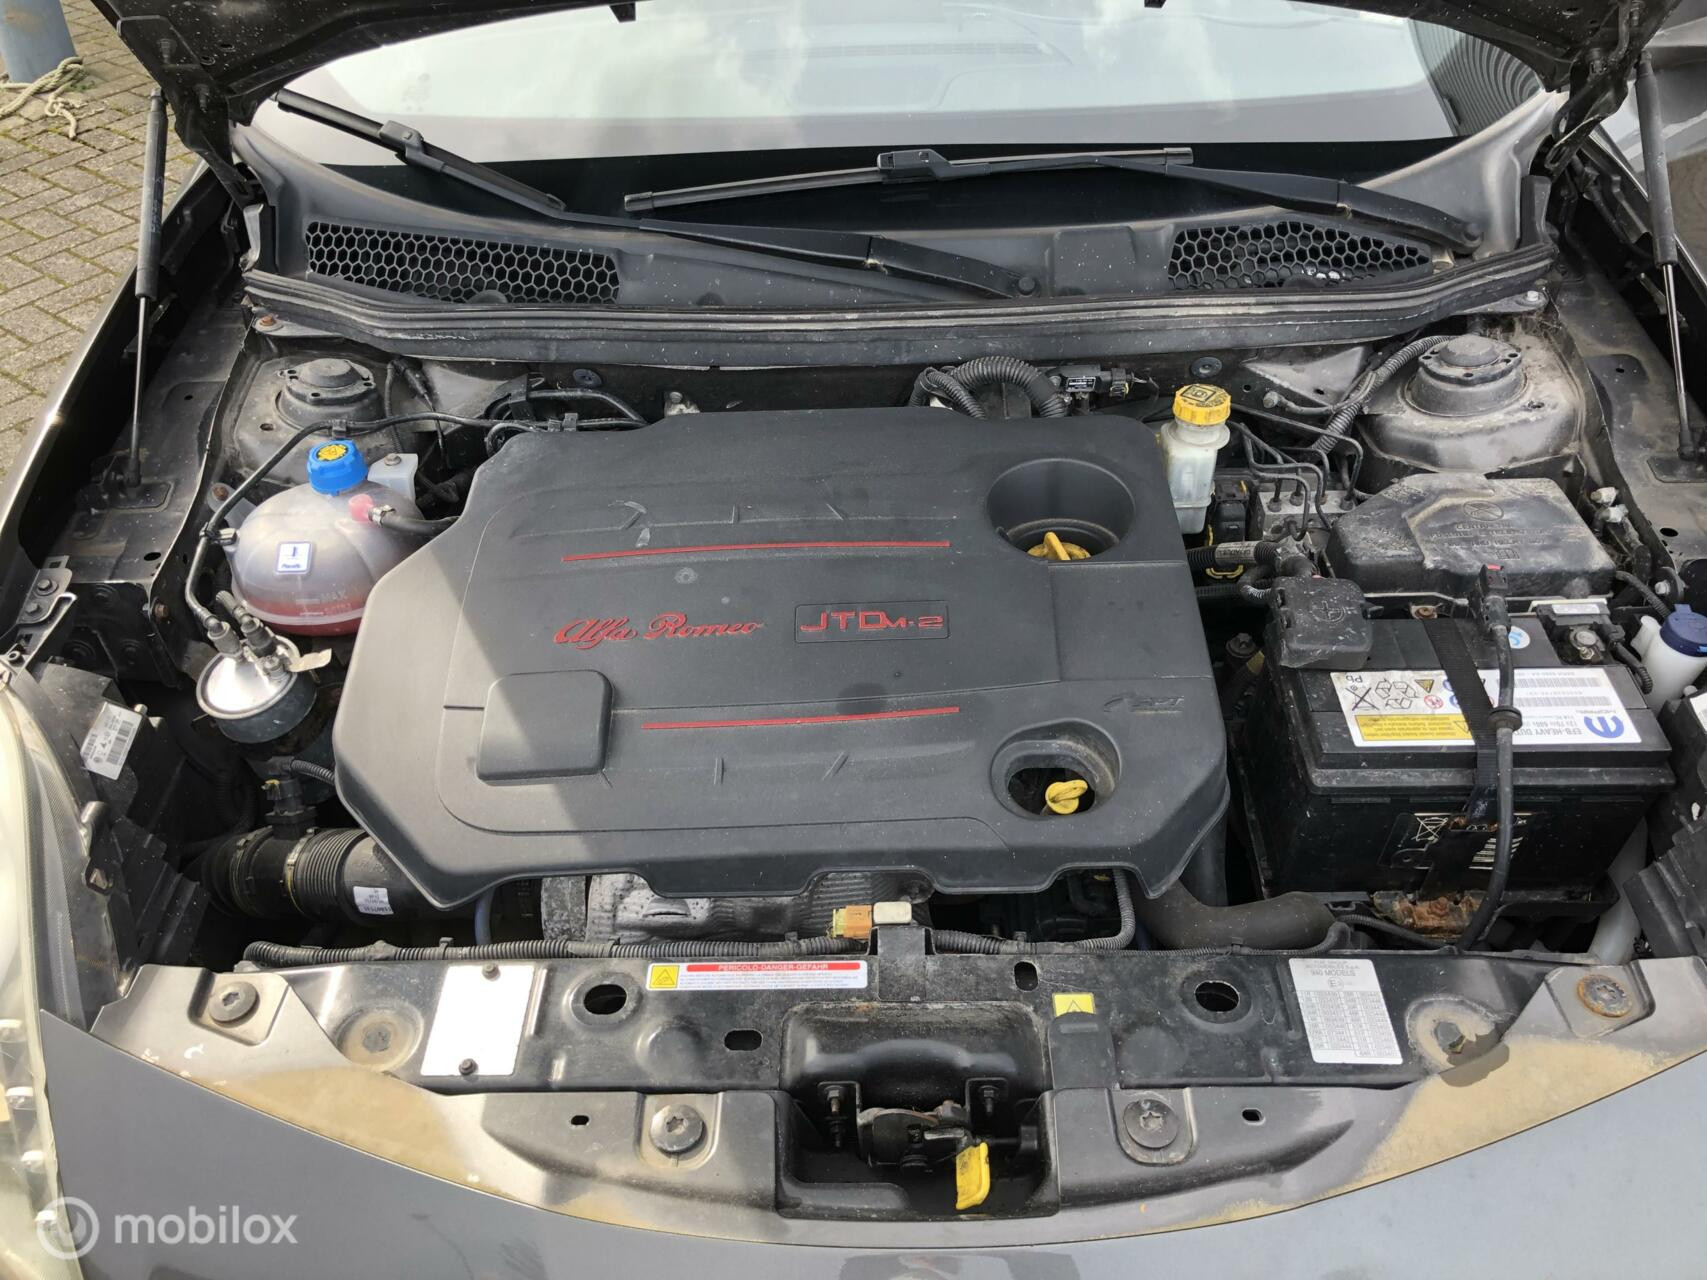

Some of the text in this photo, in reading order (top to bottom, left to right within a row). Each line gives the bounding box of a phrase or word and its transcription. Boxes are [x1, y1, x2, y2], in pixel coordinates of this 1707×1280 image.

[554, 611, 764, 650] Alfa Romeo
[1345, 675, 1363, 683] Pb
[718, 963, 828, 972] PERICOLO-DANGER-GEFAHR
